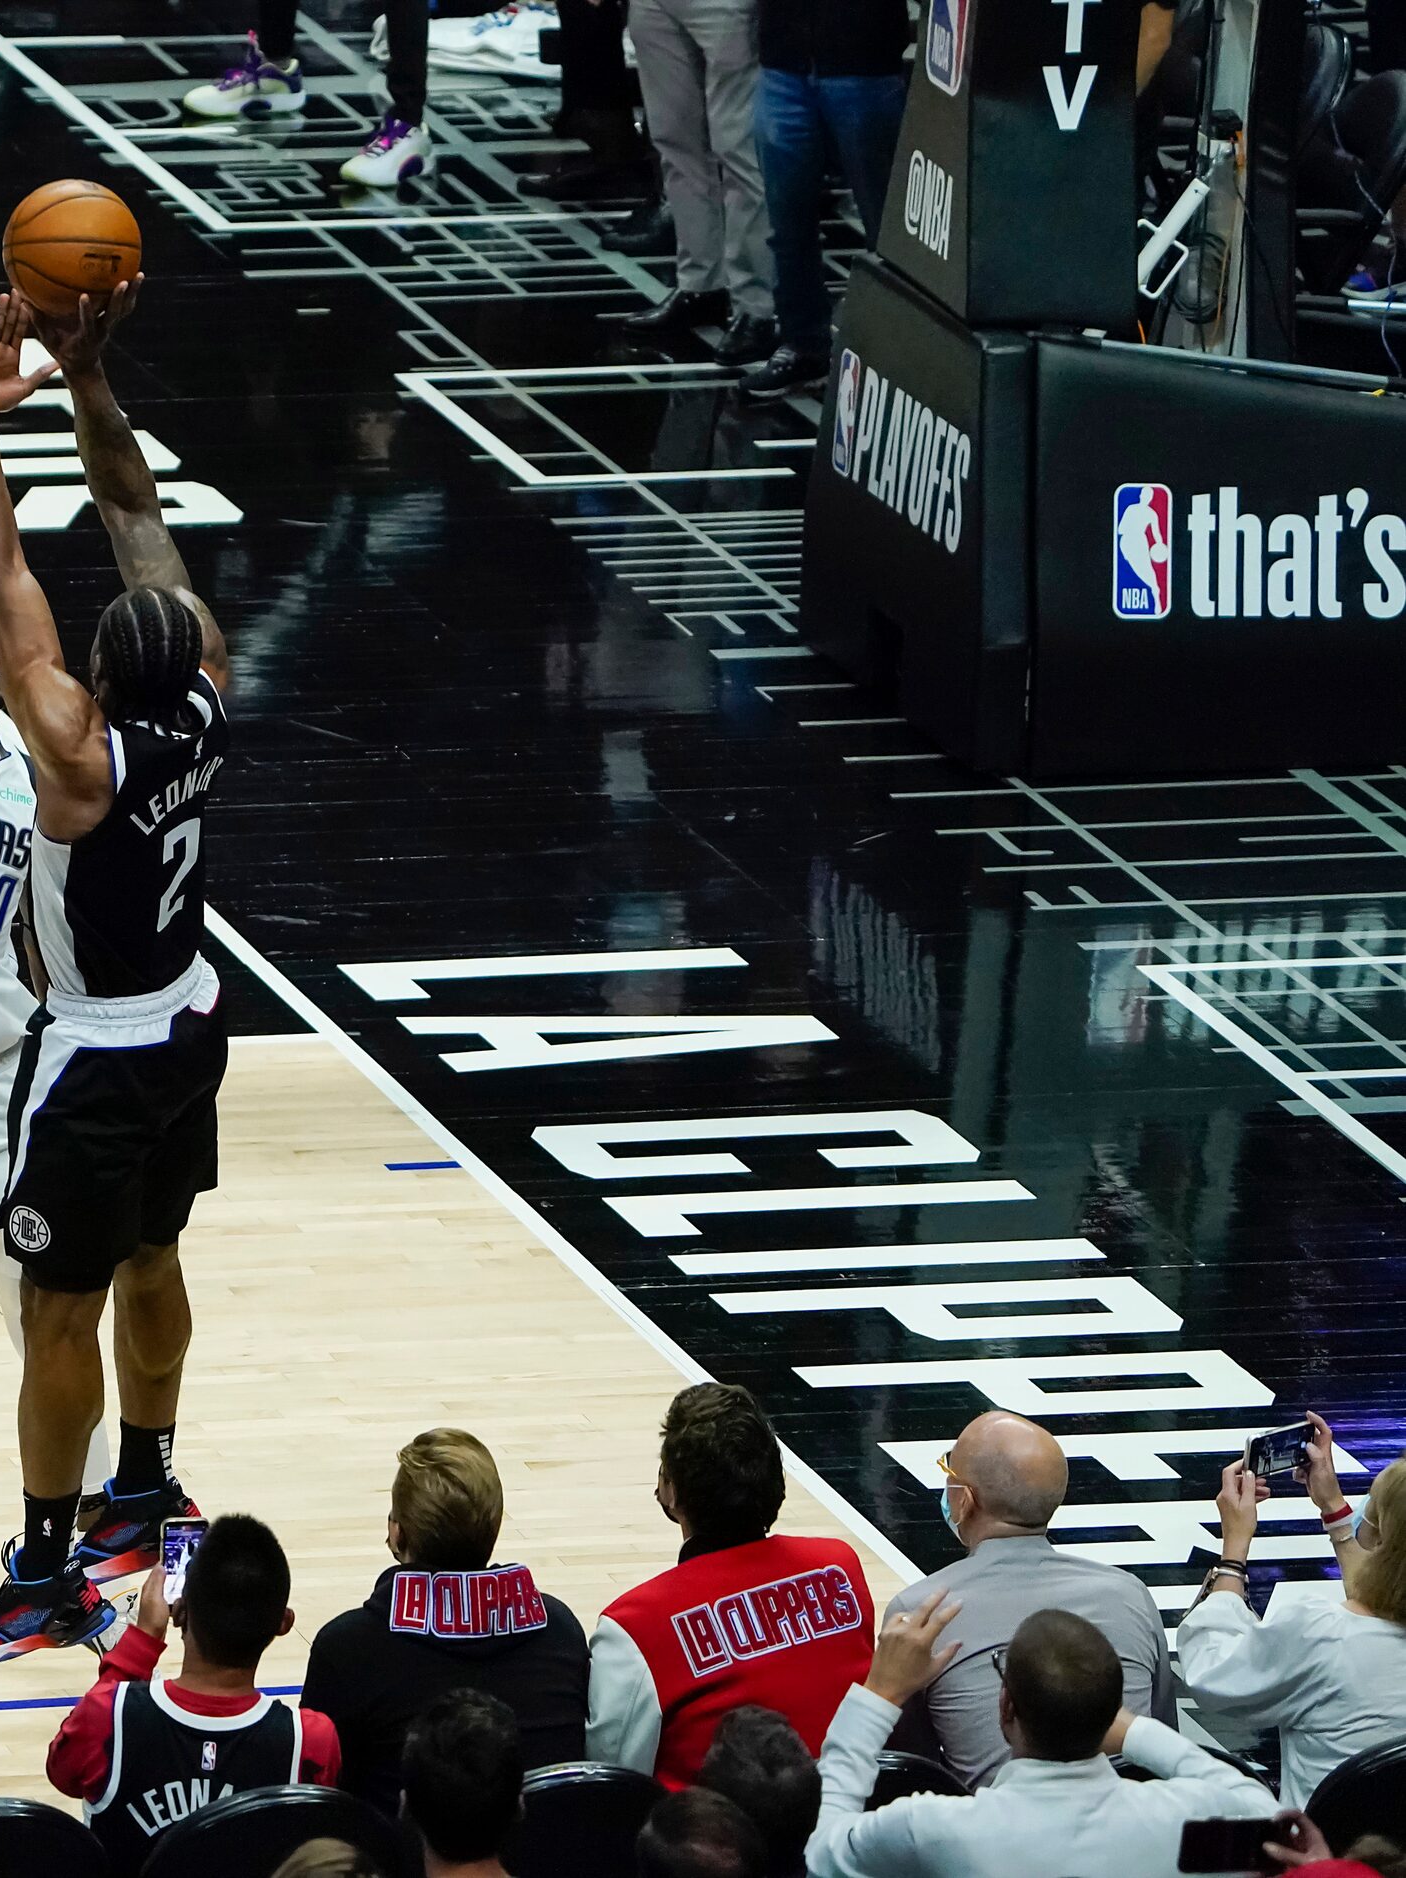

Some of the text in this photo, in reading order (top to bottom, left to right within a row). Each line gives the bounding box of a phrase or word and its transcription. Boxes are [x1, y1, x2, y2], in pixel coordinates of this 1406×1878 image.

[904, 149, 953, 261] @NBA
[852, 365, 971, 554] PLAYOFFS
[1121, 588, 1149, 610] NBA
[1187, 486, 1406, 619] that's
[0, 787, 34, 807] chime
[156, 817, 201, 933] 2
[336, 947, 840, 1074] LA
[531, 1109, 1374, 1652] CLIPPER
[391, 1564, 547, 1637] LA CLIPPERS
[672, 1566, 861, 1676] LA CLIPPERS
